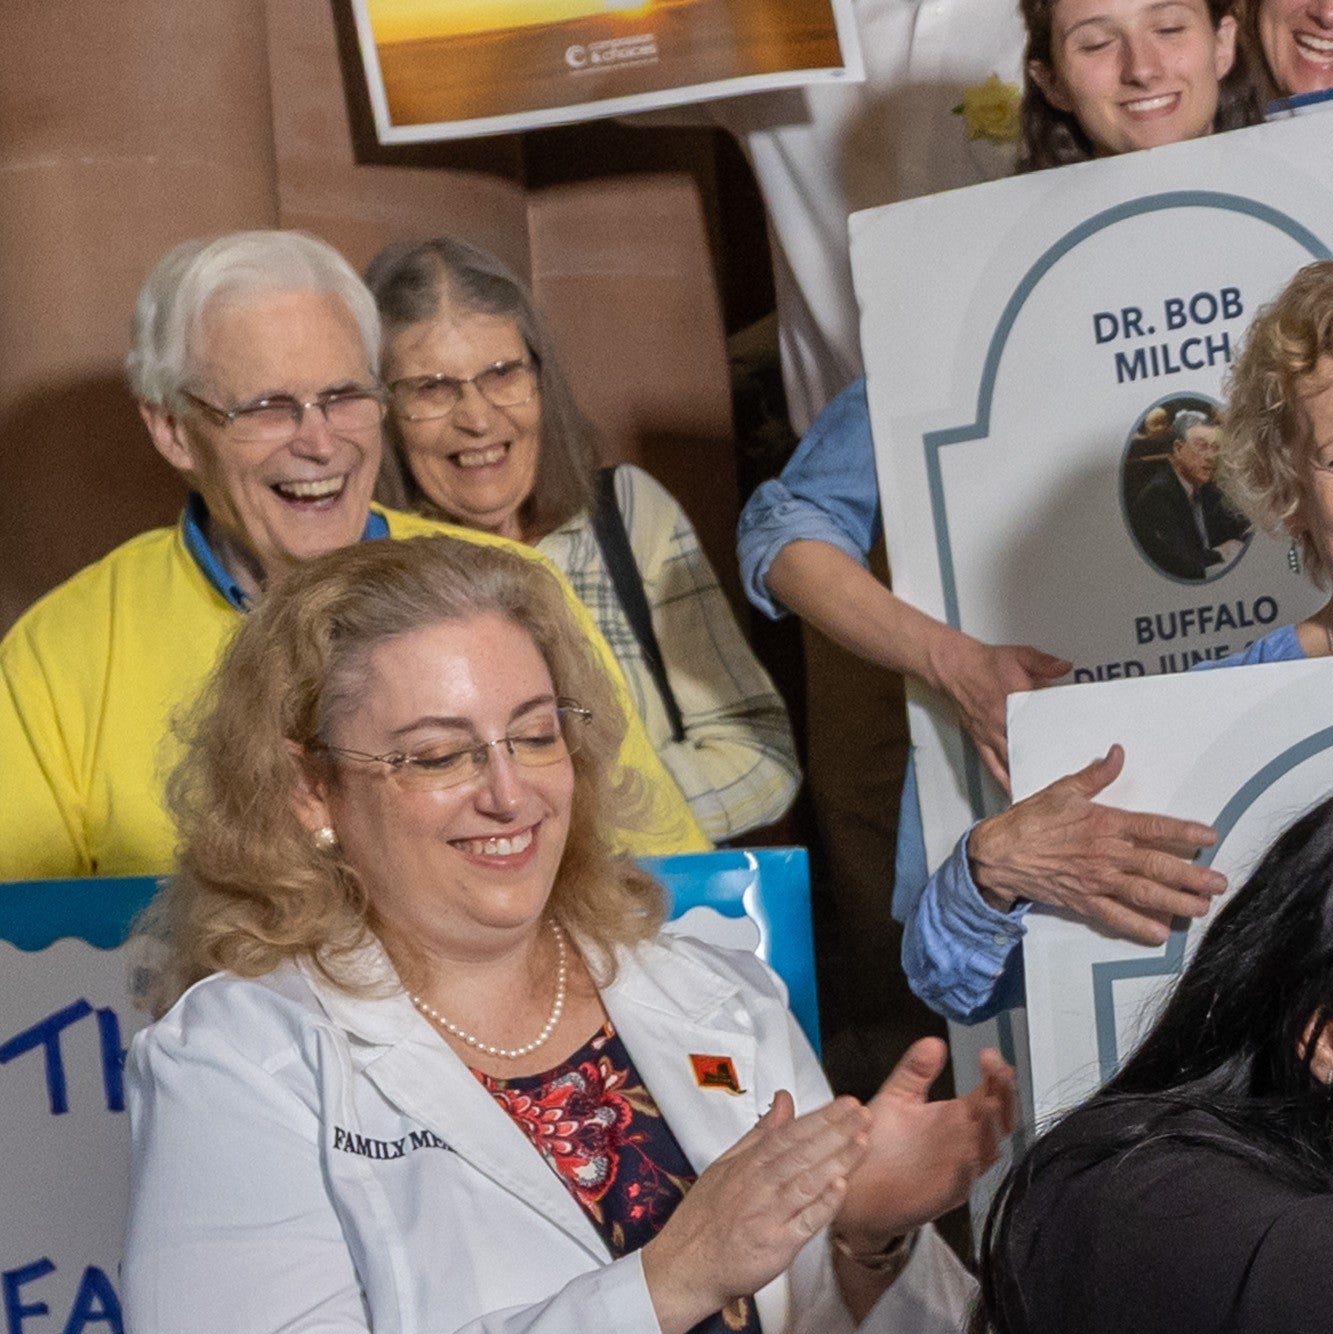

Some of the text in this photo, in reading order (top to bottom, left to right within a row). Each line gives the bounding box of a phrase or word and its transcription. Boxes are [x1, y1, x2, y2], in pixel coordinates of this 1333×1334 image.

[1093, 287, 1243, 344] DR. BOB
[1114, 332, 1231, 384] MILCH
[1134, 595, 1279, 645] BUFFALO
[333, 1125, 407, 1161] FAMILY
